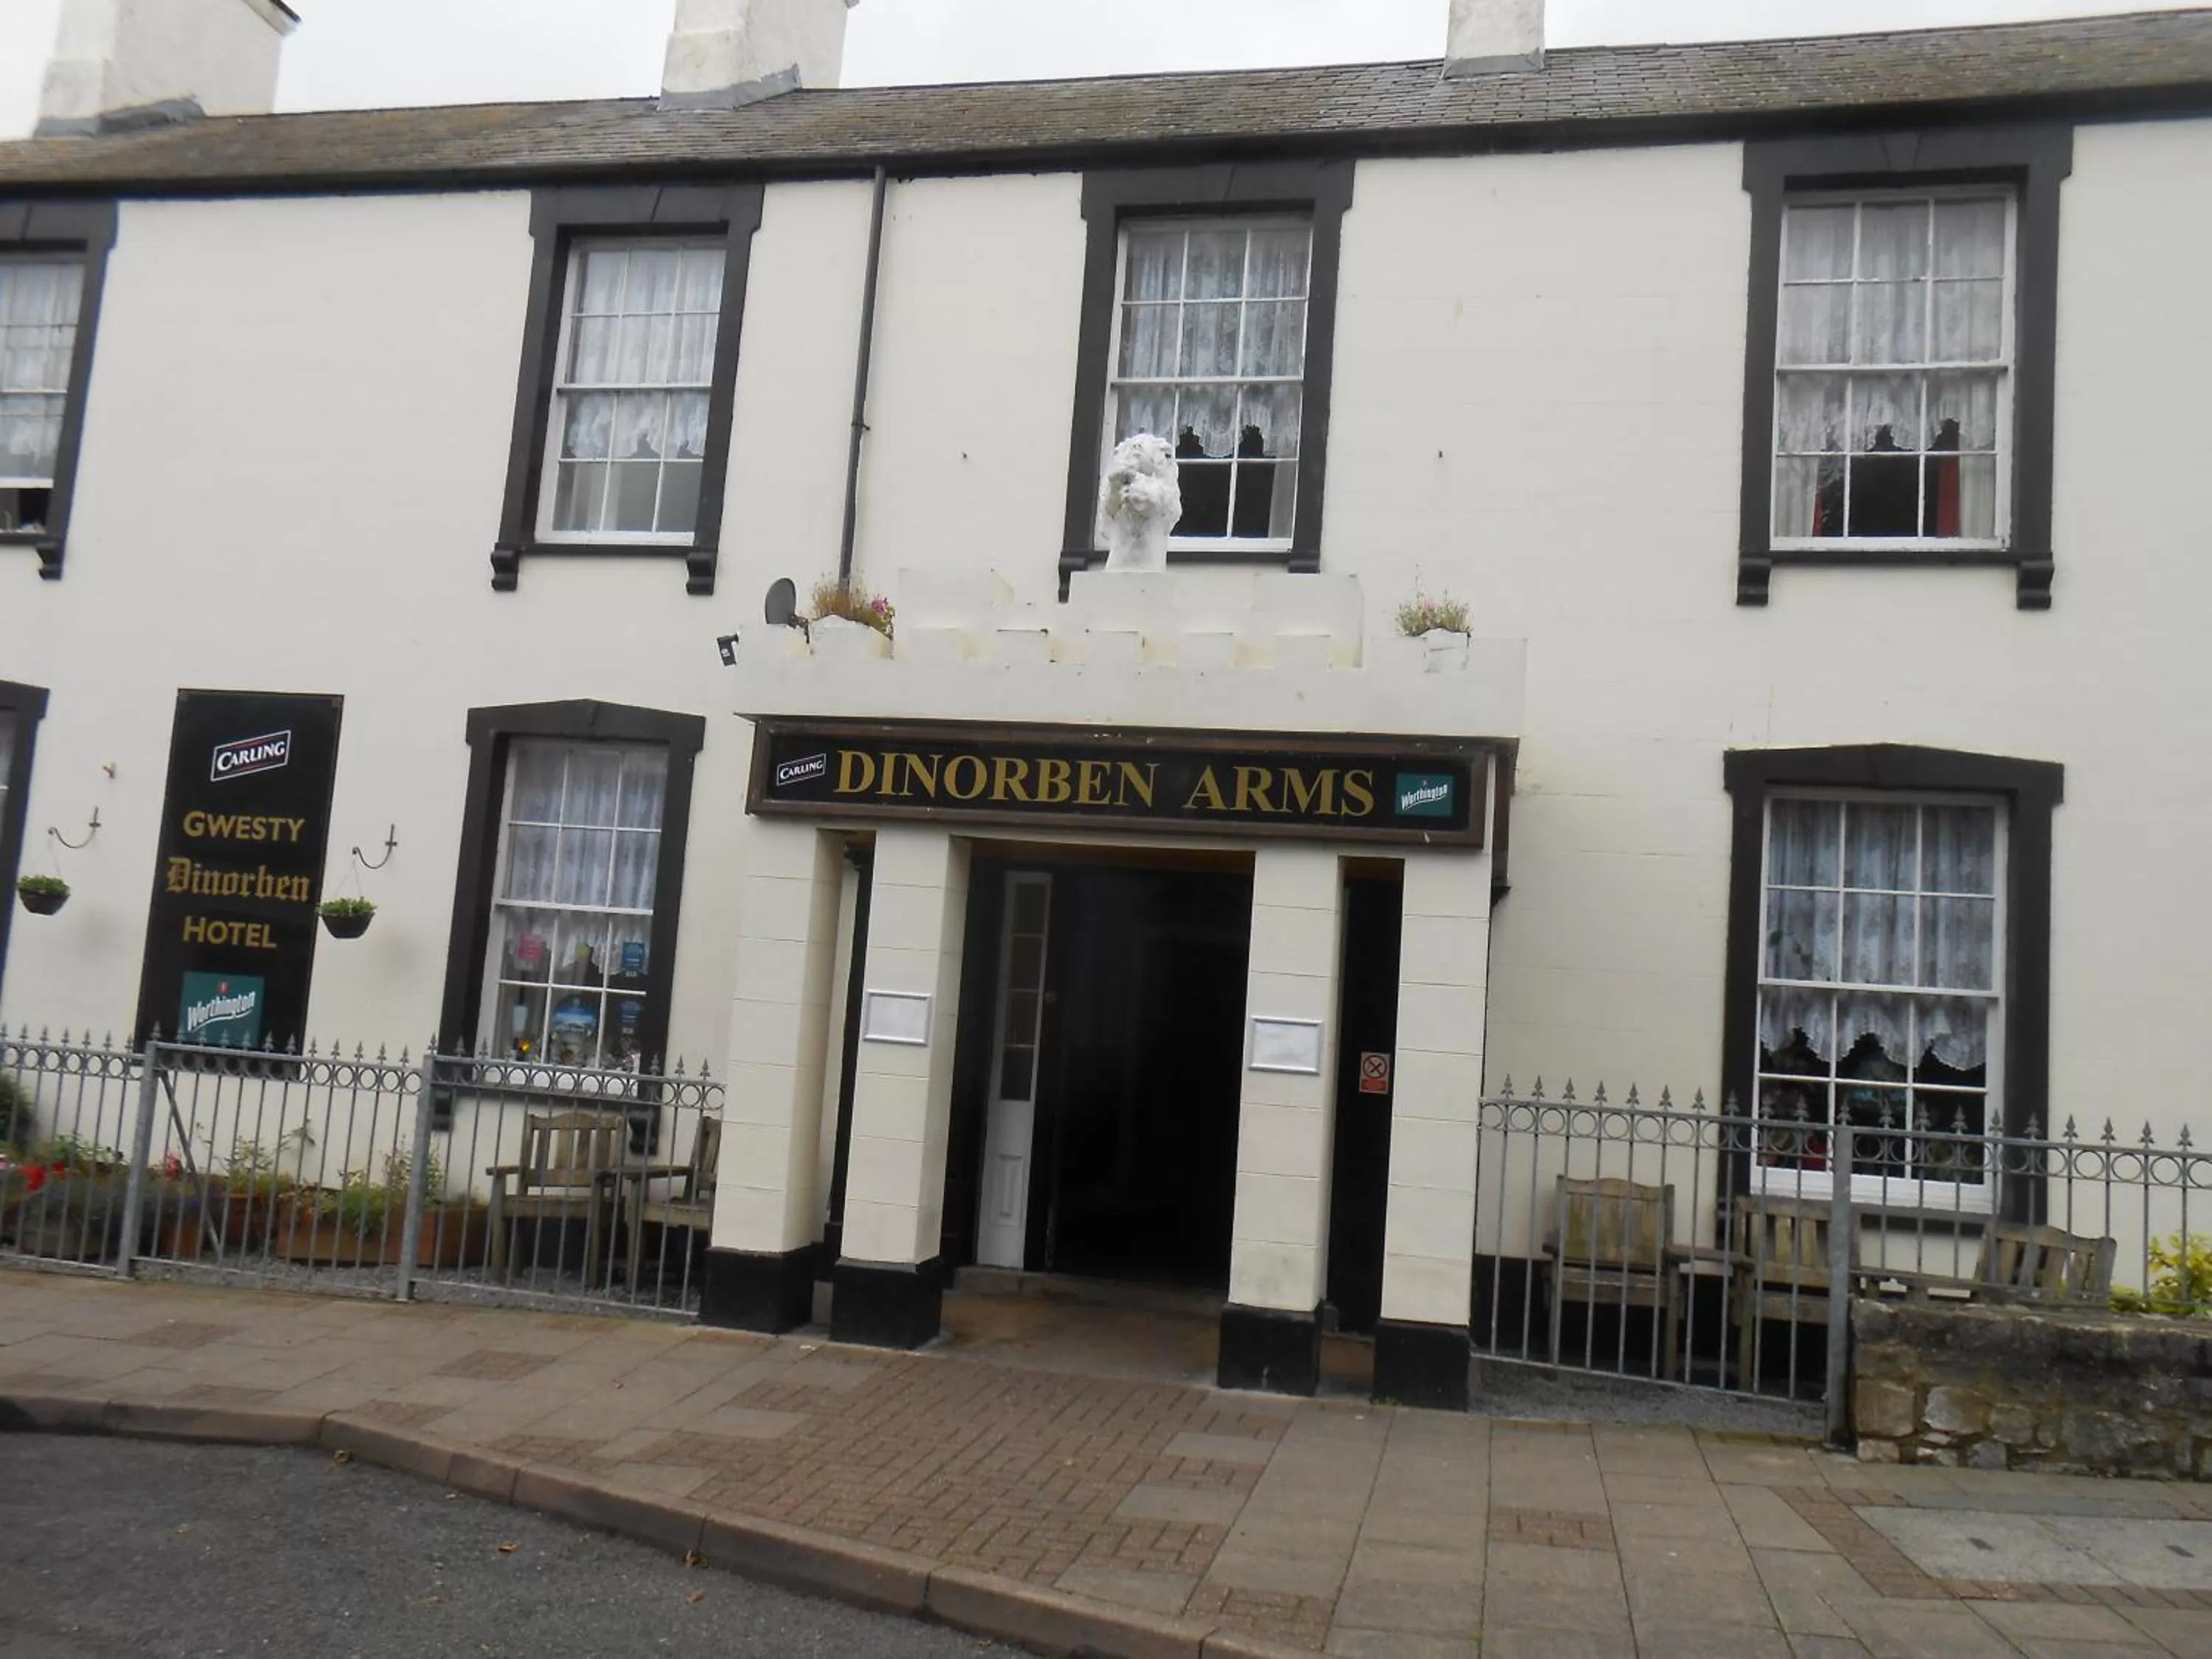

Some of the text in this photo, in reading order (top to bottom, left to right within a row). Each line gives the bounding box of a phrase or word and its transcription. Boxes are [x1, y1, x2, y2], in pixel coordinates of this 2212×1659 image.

[218, 740, 285, 771] CARLING
[780, 761, 823, 779] CARLING
[834, 750, 1374, 816] DINORBEN ARMS
[184, 811, 305, 841] GWESTY
[167, 858, 310, 901] Dinorben
[183, 917, 276, 948] HOTEL
[187, 991, 255, 1031] Worthington
